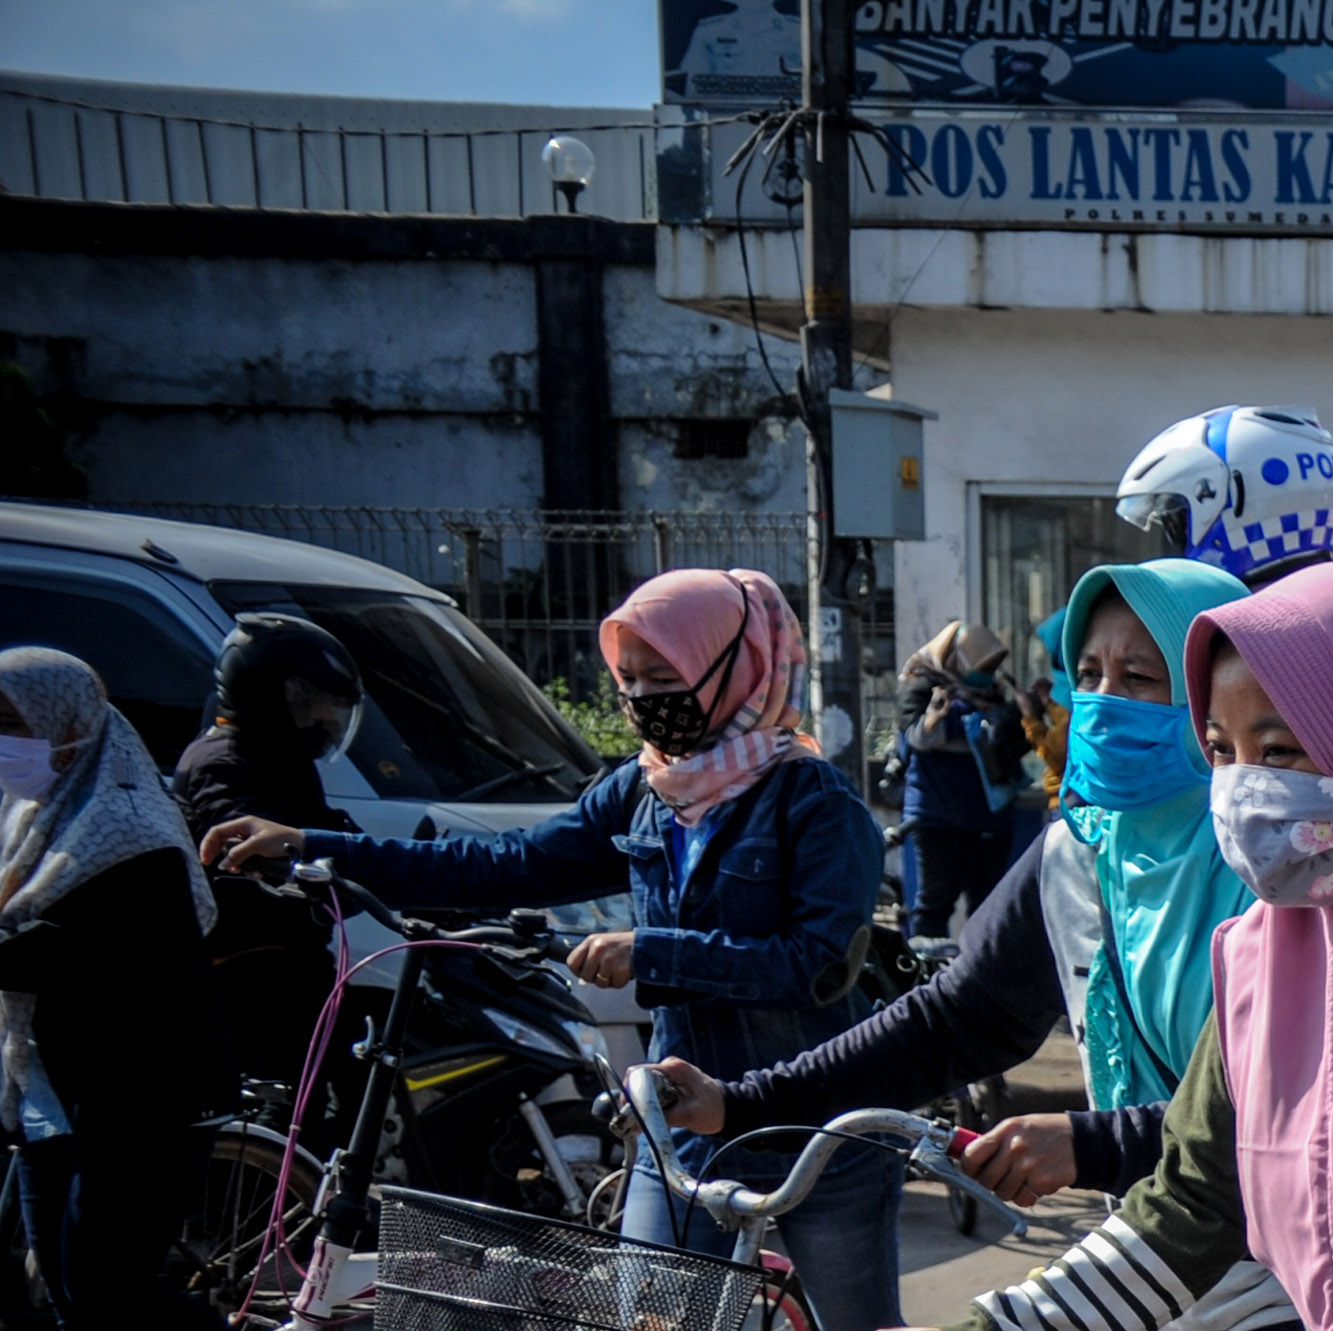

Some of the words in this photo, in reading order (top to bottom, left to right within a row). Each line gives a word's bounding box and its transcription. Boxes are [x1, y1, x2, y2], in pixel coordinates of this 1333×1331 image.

[855, 0, 1037, 36] BANYAK
[885, 124, 1007, 199] POS
[1030, 126, 1250, 202] LANTAS
[1064, 209, 1187, 221] POLRES
